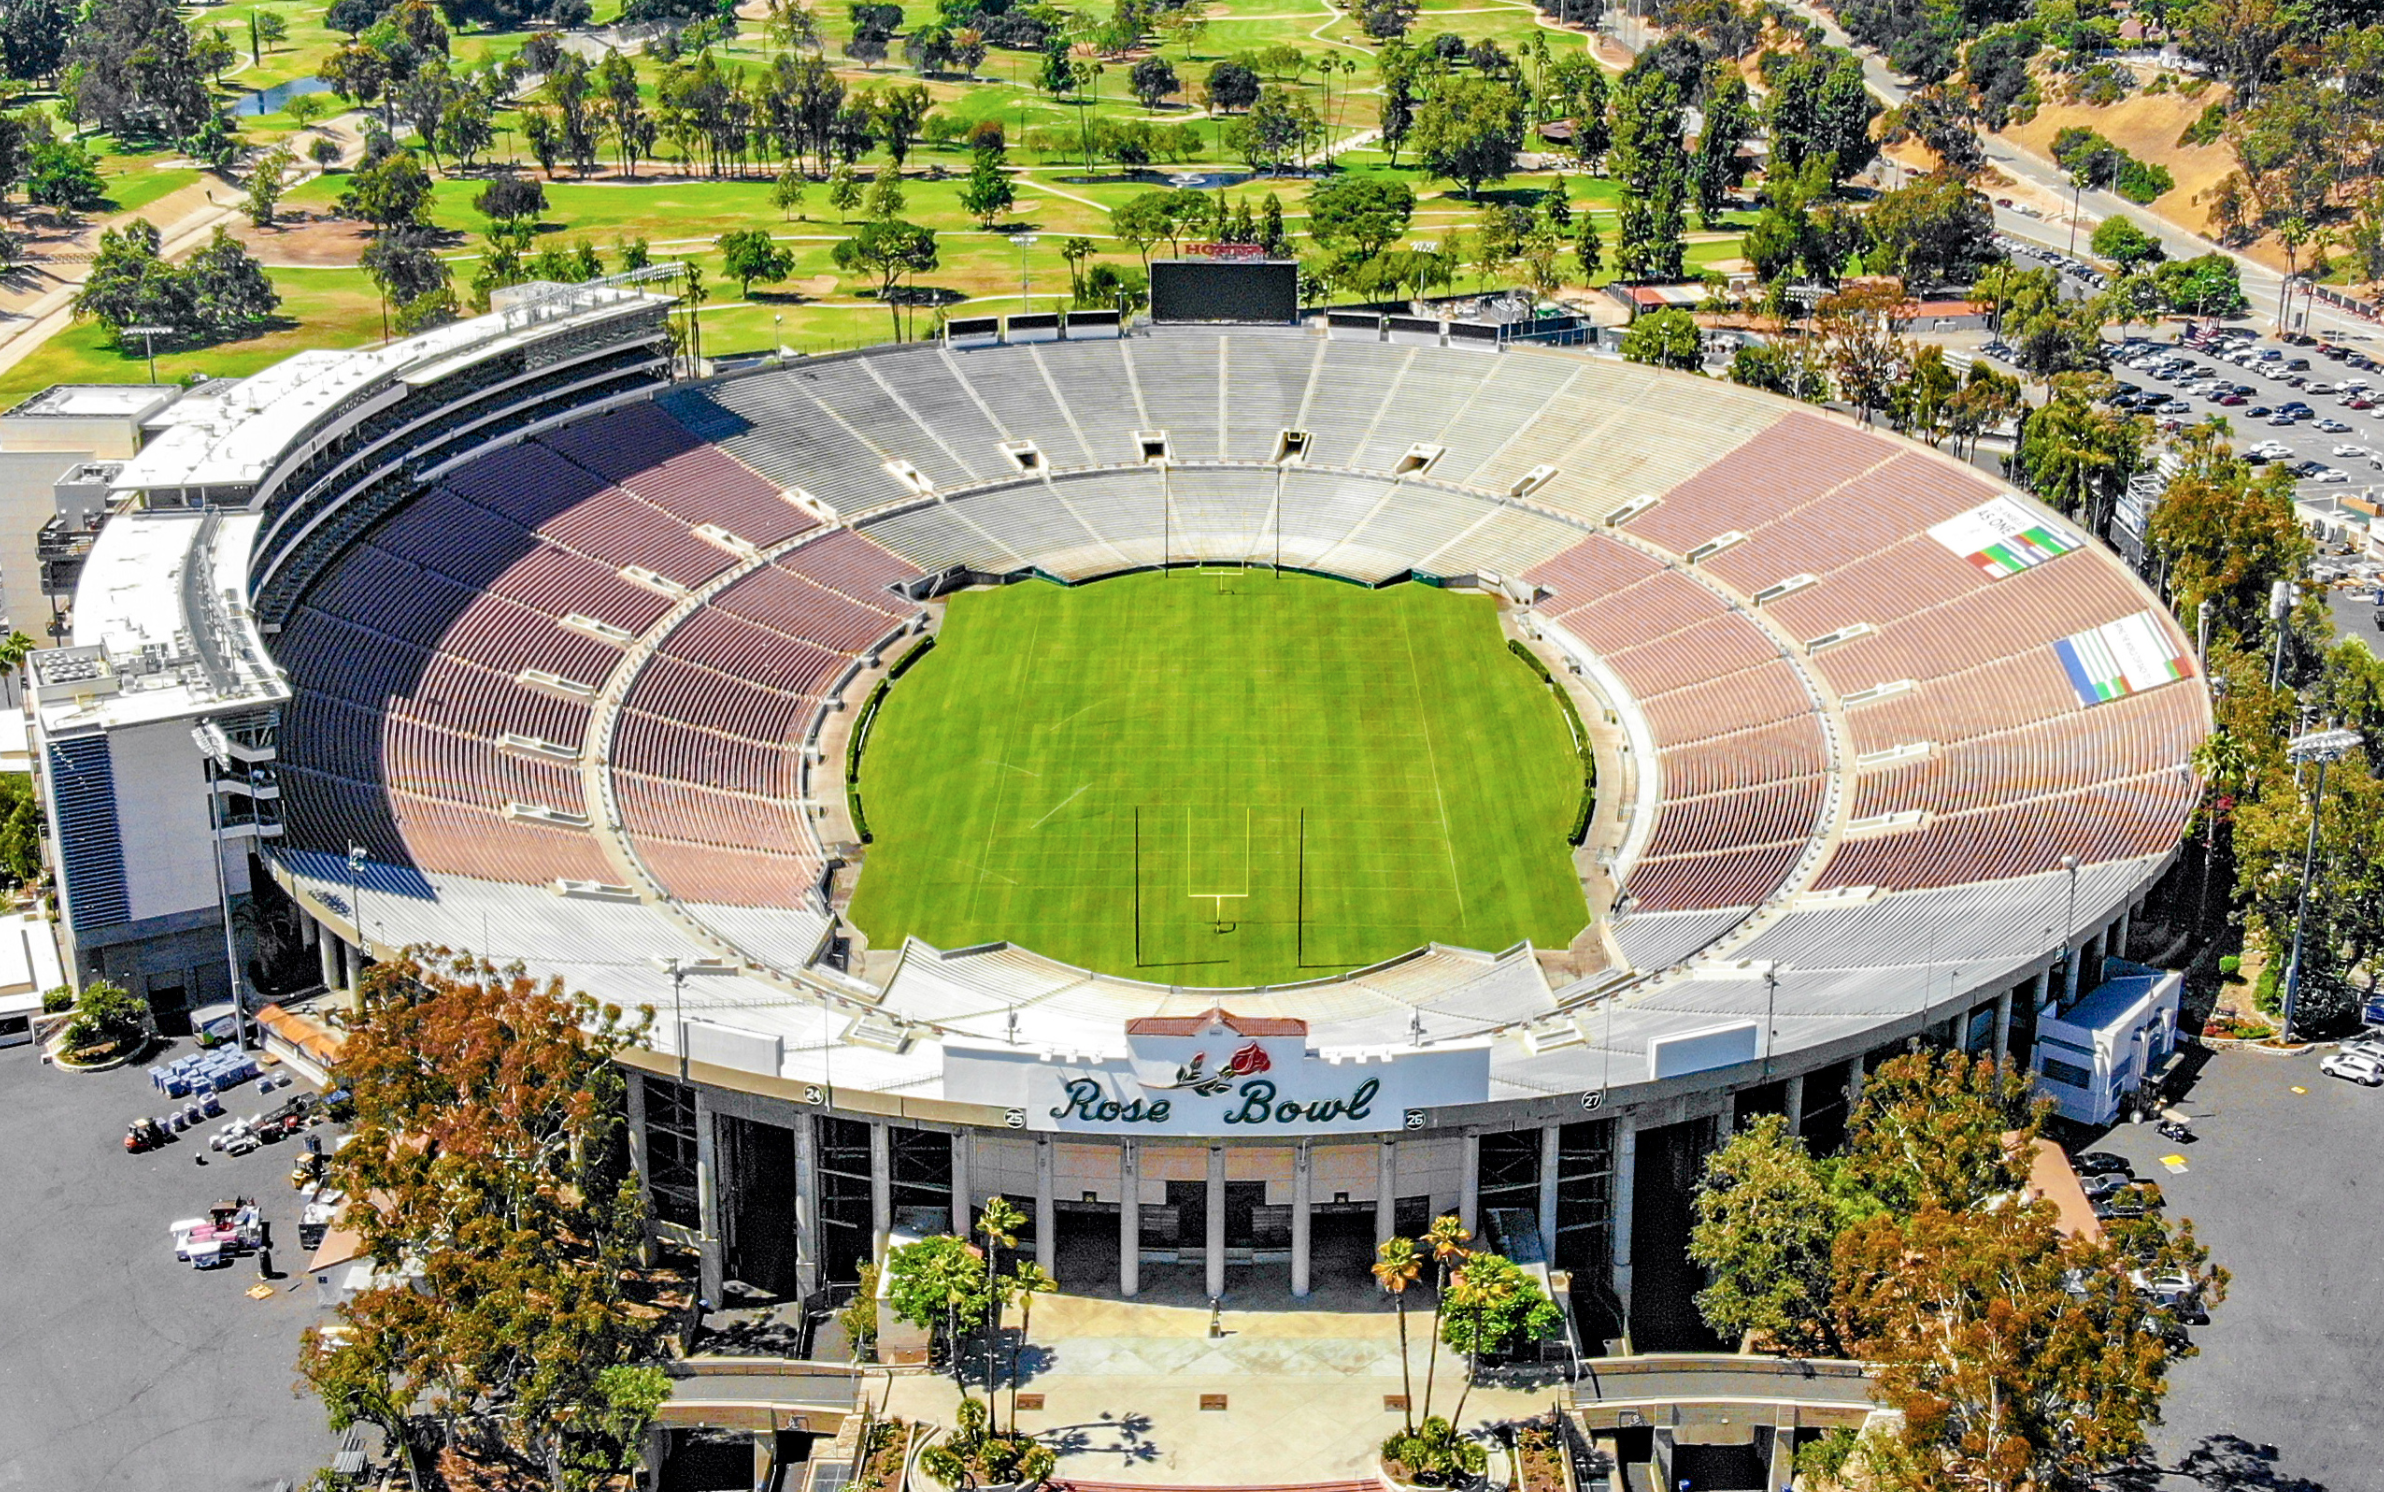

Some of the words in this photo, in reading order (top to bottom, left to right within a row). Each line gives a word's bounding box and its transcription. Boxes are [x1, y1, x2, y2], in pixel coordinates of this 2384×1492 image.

[1976, 509, 1996, 521] AS
[1989, 518, 2016, 535] ONE
[806, 1087, 821, 1101] 24
[1049, 1078, 1171, 1123] Rose
[1223, 1077, 1380, 1124] Bowl
[1584, 1095, 1600, 1107] 27
[1006, 1111, 1023, 1124] 25
[1406, 1114, 1424, 1126] 26
